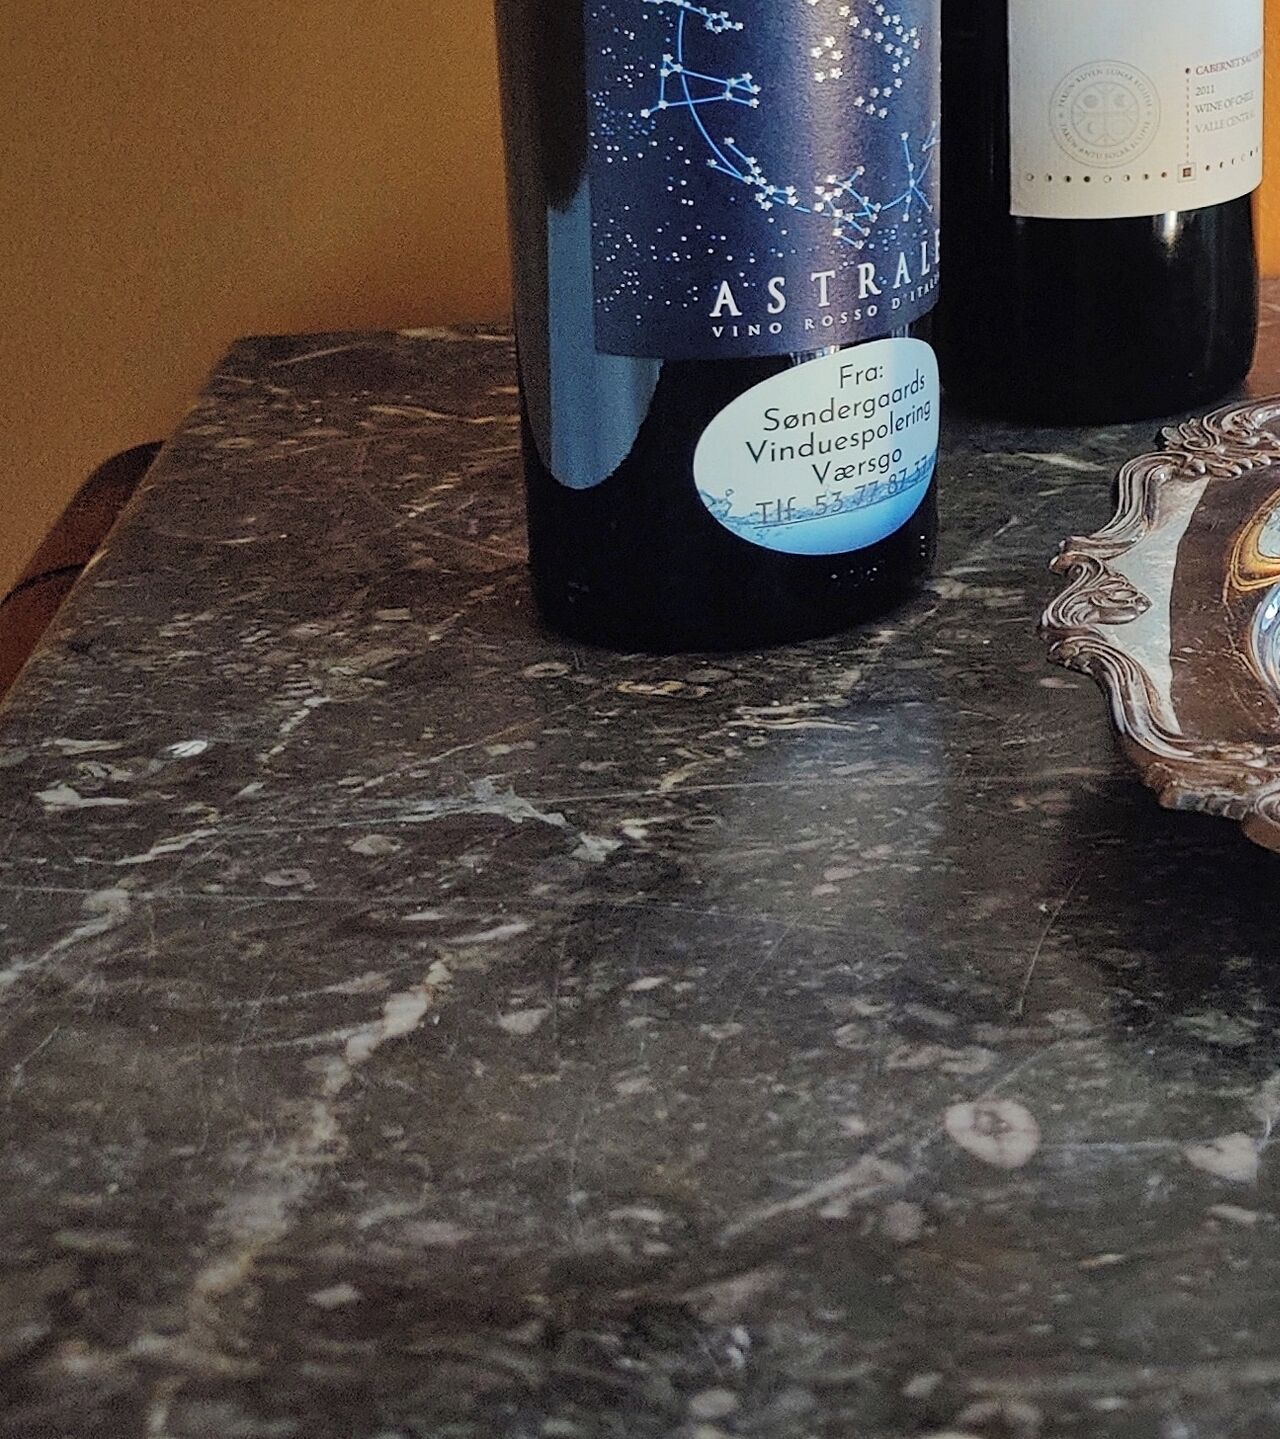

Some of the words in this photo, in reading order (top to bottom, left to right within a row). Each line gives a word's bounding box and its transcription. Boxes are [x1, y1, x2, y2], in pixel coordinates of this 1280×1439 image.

[1195, 84, 1215, 96] 2011
[1195, 100, 1223, 113] WINE
[712, 322, 783, 338] VINO
[804, 304, 879, 331] ROSSO
[839, 363, 884, 390] Fra:
[763, 368, 926, 432] Søndergaards
[745, 400, 931, 464] Vinduespolering
[811, 448, 903, 484] Værsgo
[815, 490, 844, 516] 53
[887, 467, 908, 495] 87
